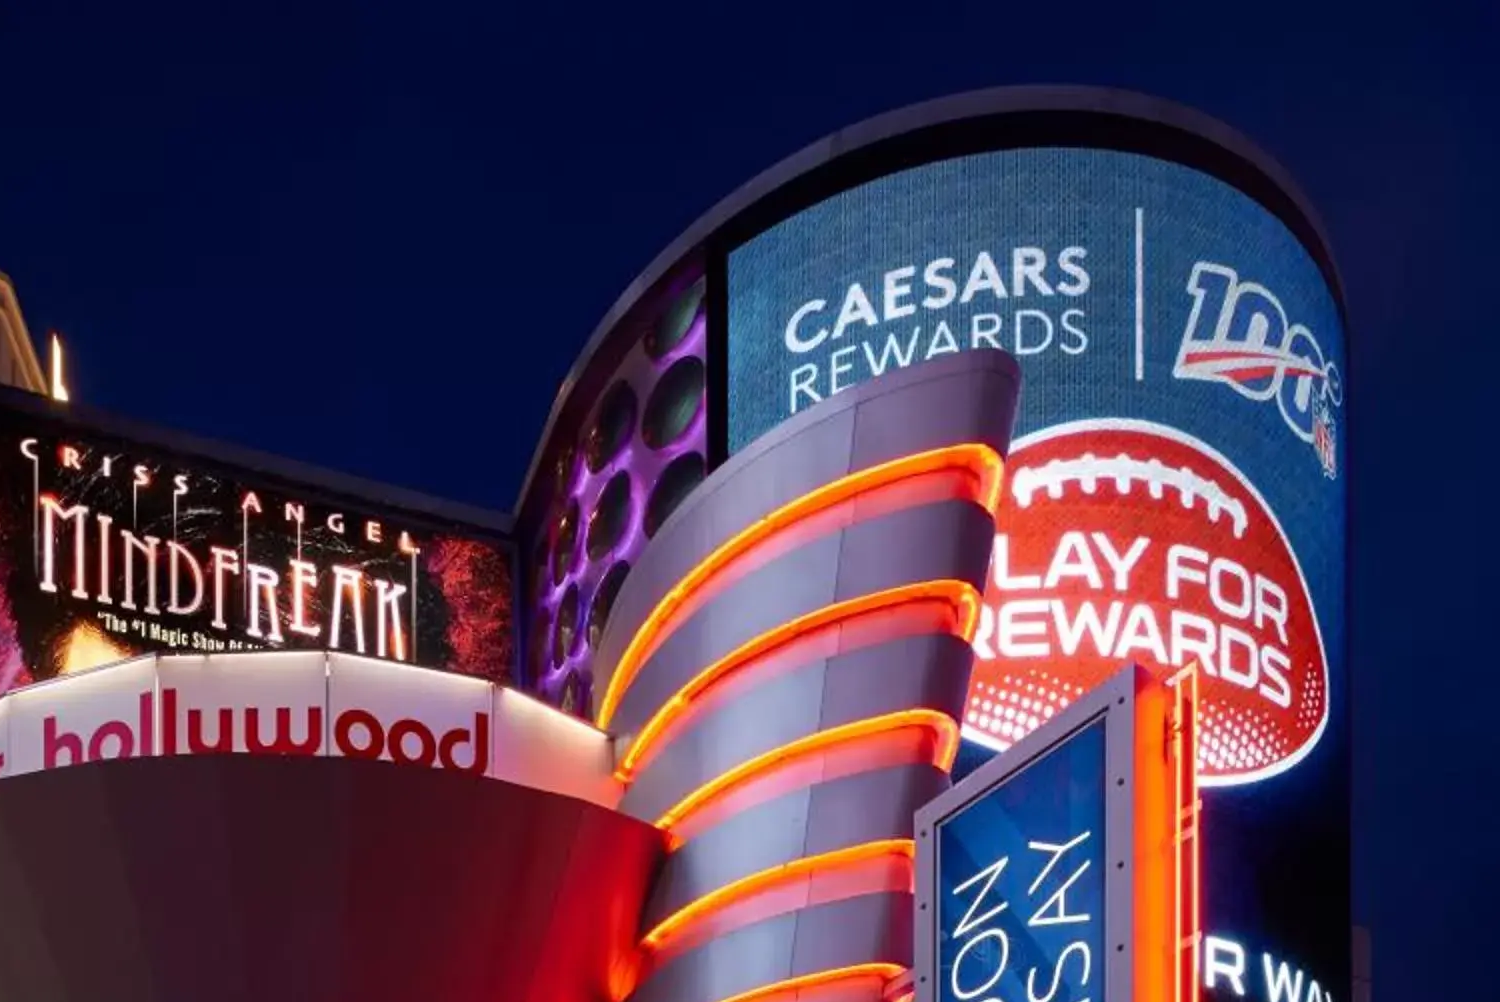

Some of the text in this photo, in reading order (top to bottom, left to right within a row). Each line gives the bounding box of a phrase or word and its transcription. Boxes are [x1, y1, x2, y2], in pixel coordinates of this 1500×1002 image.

[784, 247, 1091, 352] CAESARS
[790, 310, 1089, 414] REWARDS
[20, 438, 420, 553] CRISS ANGEL
[39, 493, 408, 662] MINDFREAK
[989, 531, 1289, 645] LAY FOR
[150, 623, 189, 648] Magic
[192, 631, 225, 651] Show
